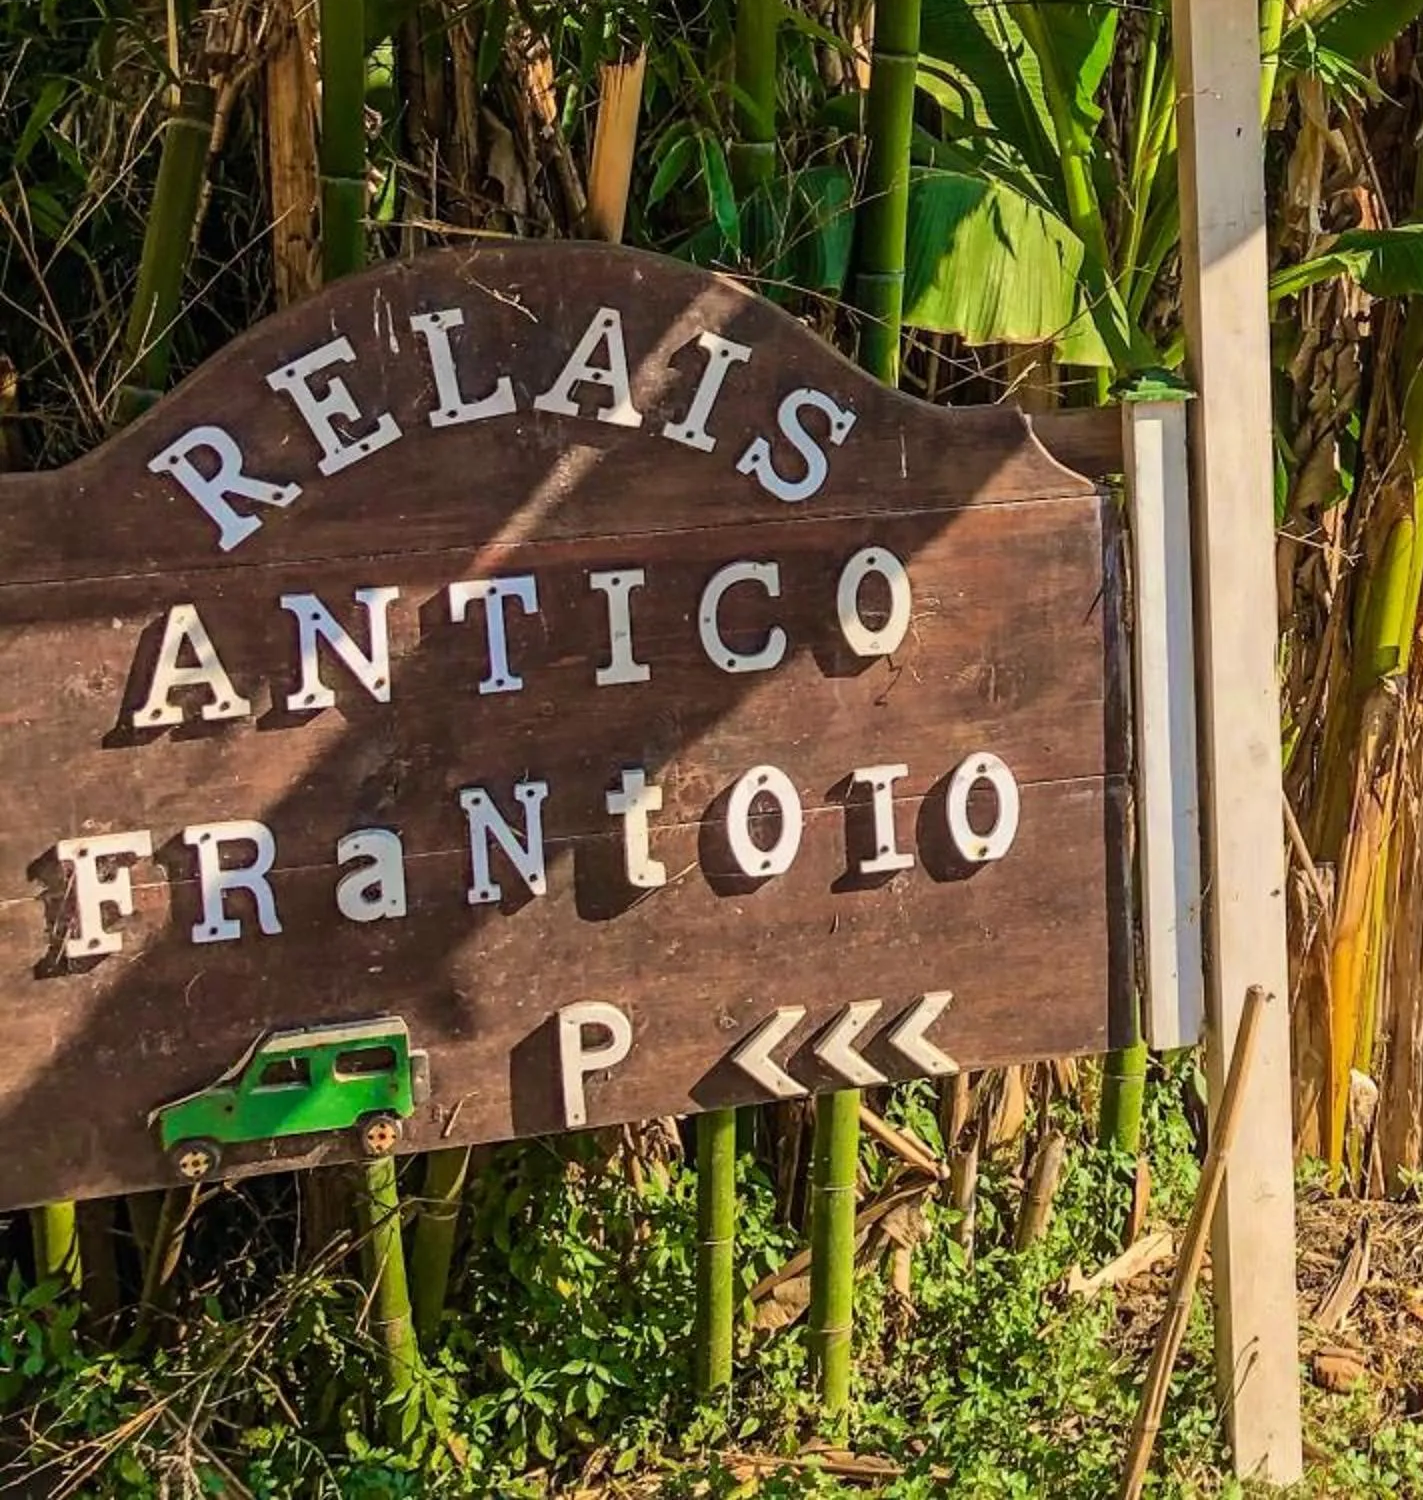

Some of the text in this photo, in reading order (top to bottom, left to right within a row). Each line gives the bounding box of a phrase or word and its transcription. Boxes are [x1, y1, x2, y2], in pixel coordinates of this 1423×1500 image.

[149, 308, 857, 551] RELAIS
[133, 546, 912, 727] ANTICO
[559, 1002, 632, 1127] P
